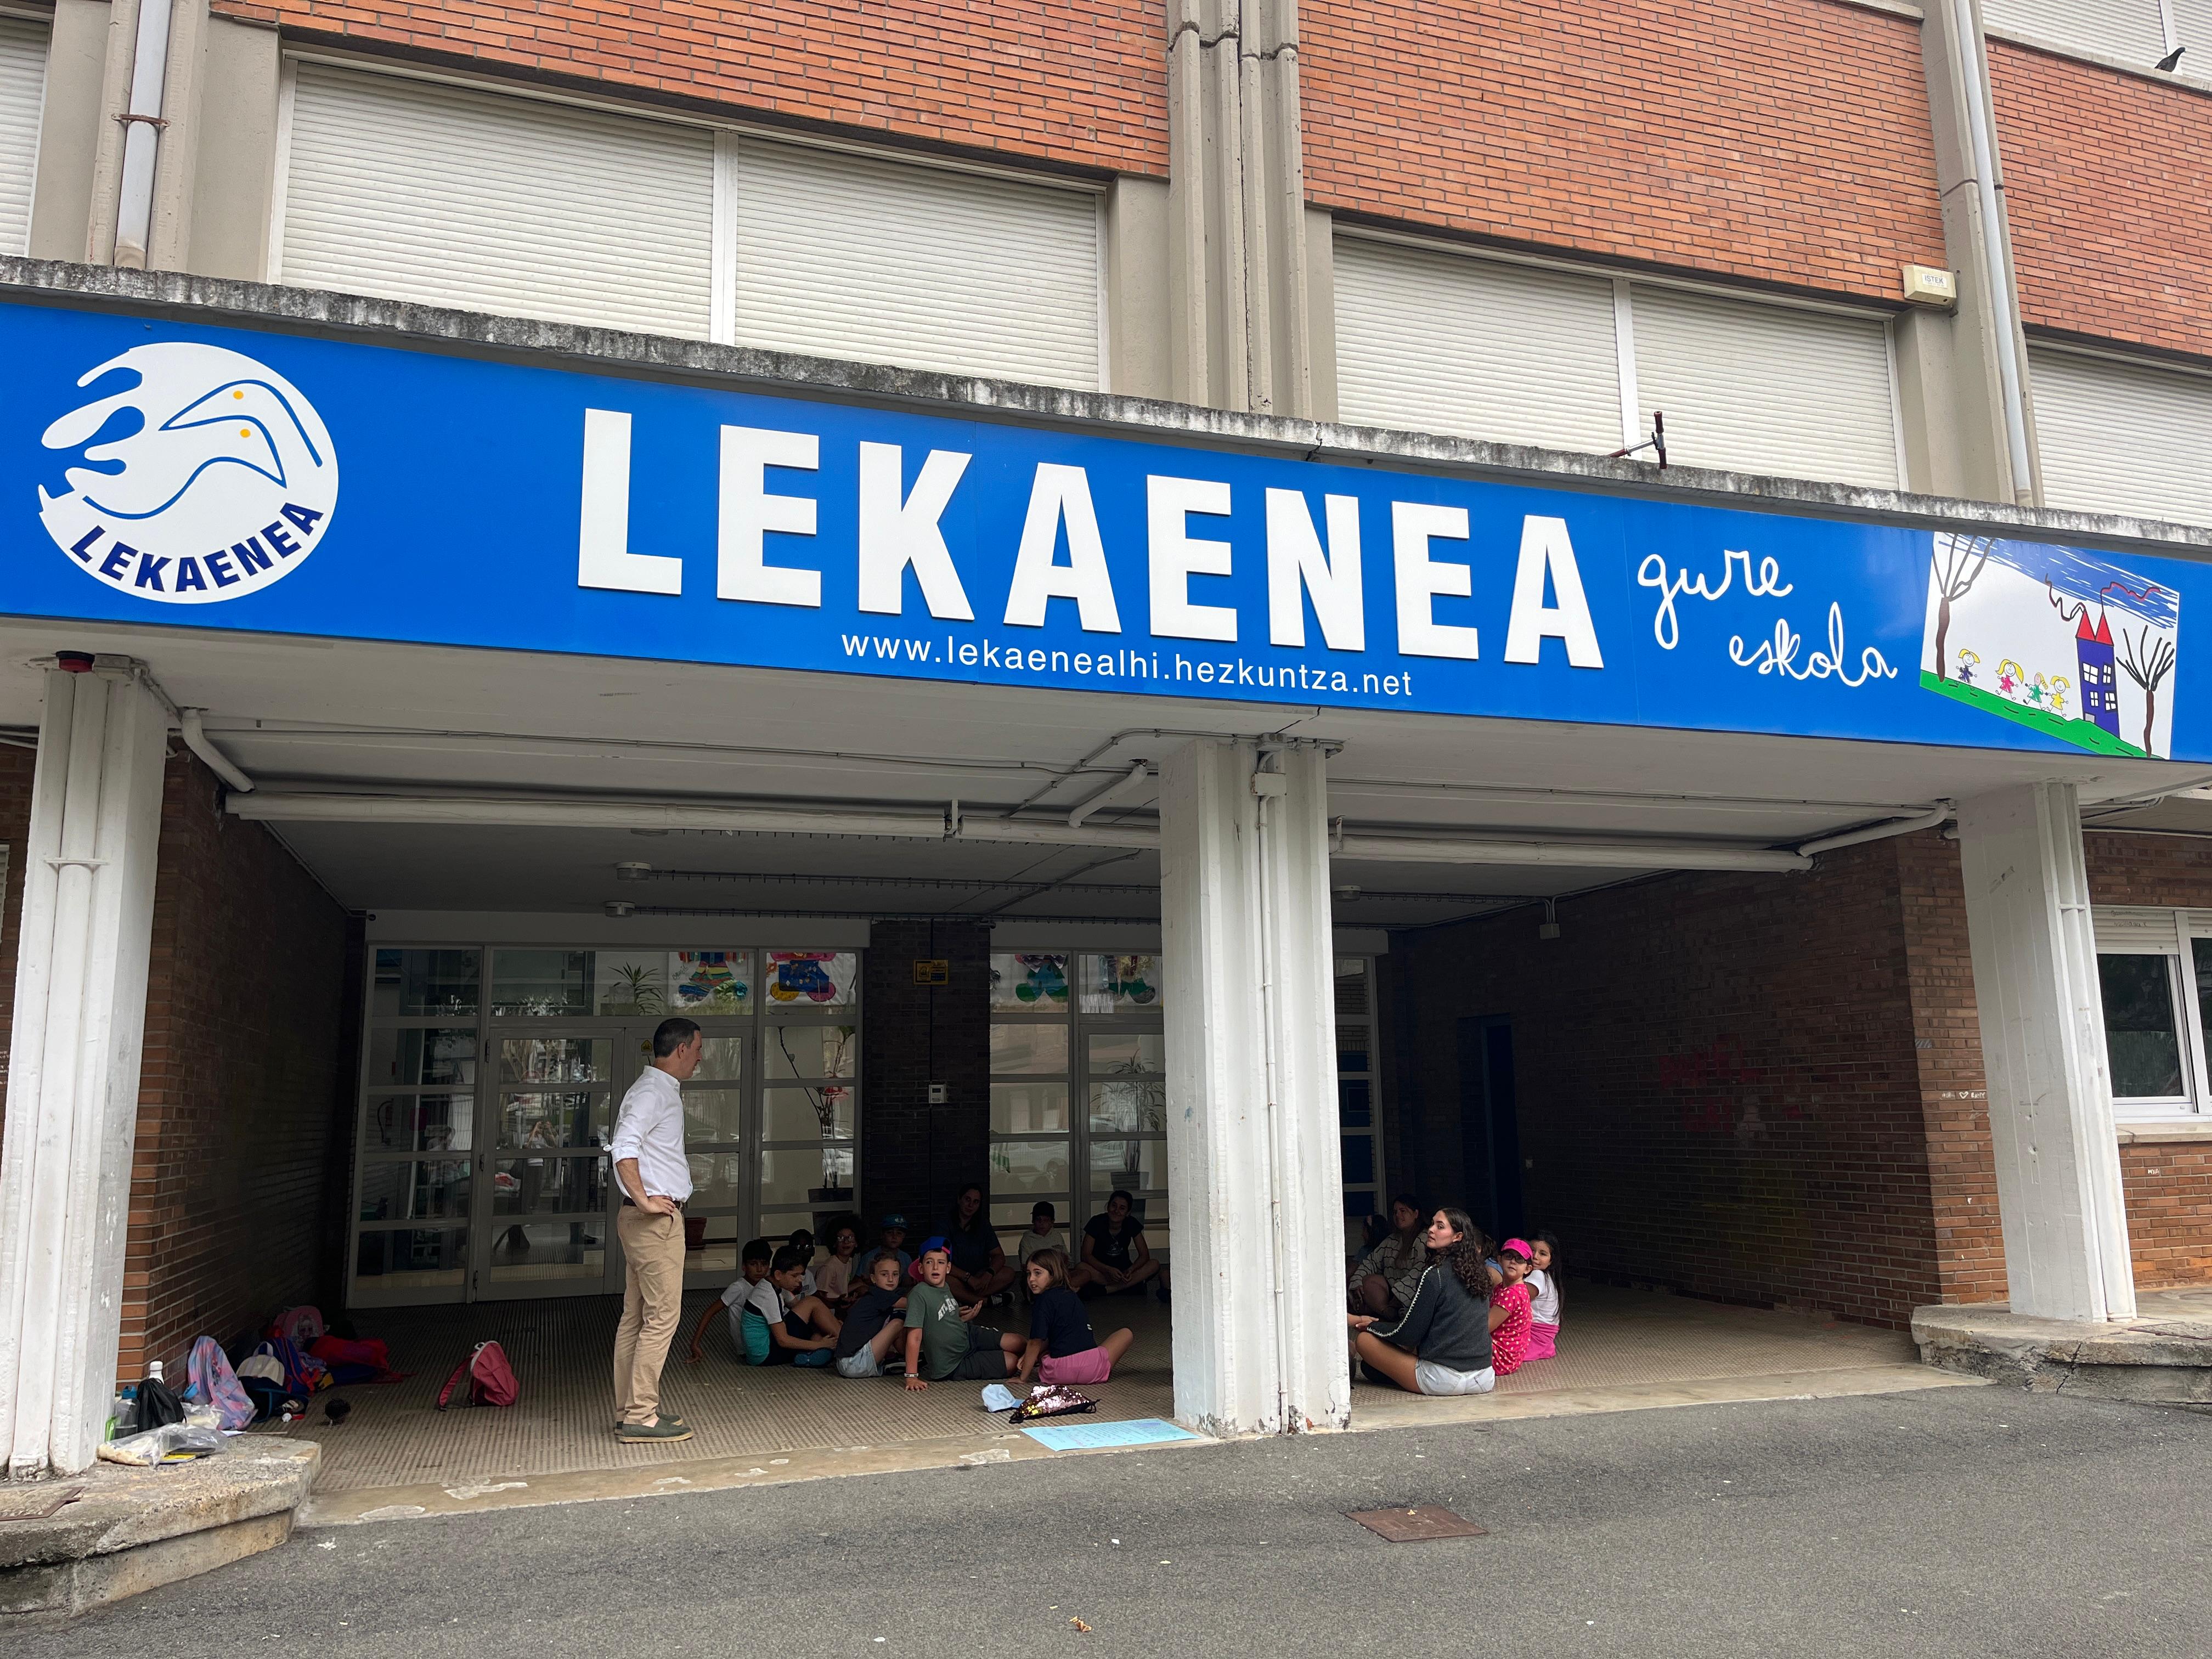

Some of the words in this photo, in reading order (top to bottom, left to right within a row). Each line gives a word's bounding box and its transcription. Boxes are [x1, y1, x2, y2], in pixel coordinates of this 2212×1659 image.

[1925, 275, 1944, 284] ISTEK
[70, 501, 323, 592] LEKAENEA
[578, 408, 1604, 668] LEKAENEA
[1637, 549, 1794, 650] gure
[842, 634, 1412, 696] www.lekaenealhi.hezkuntza.net
[1728, 601, 1899, 687] eskola
